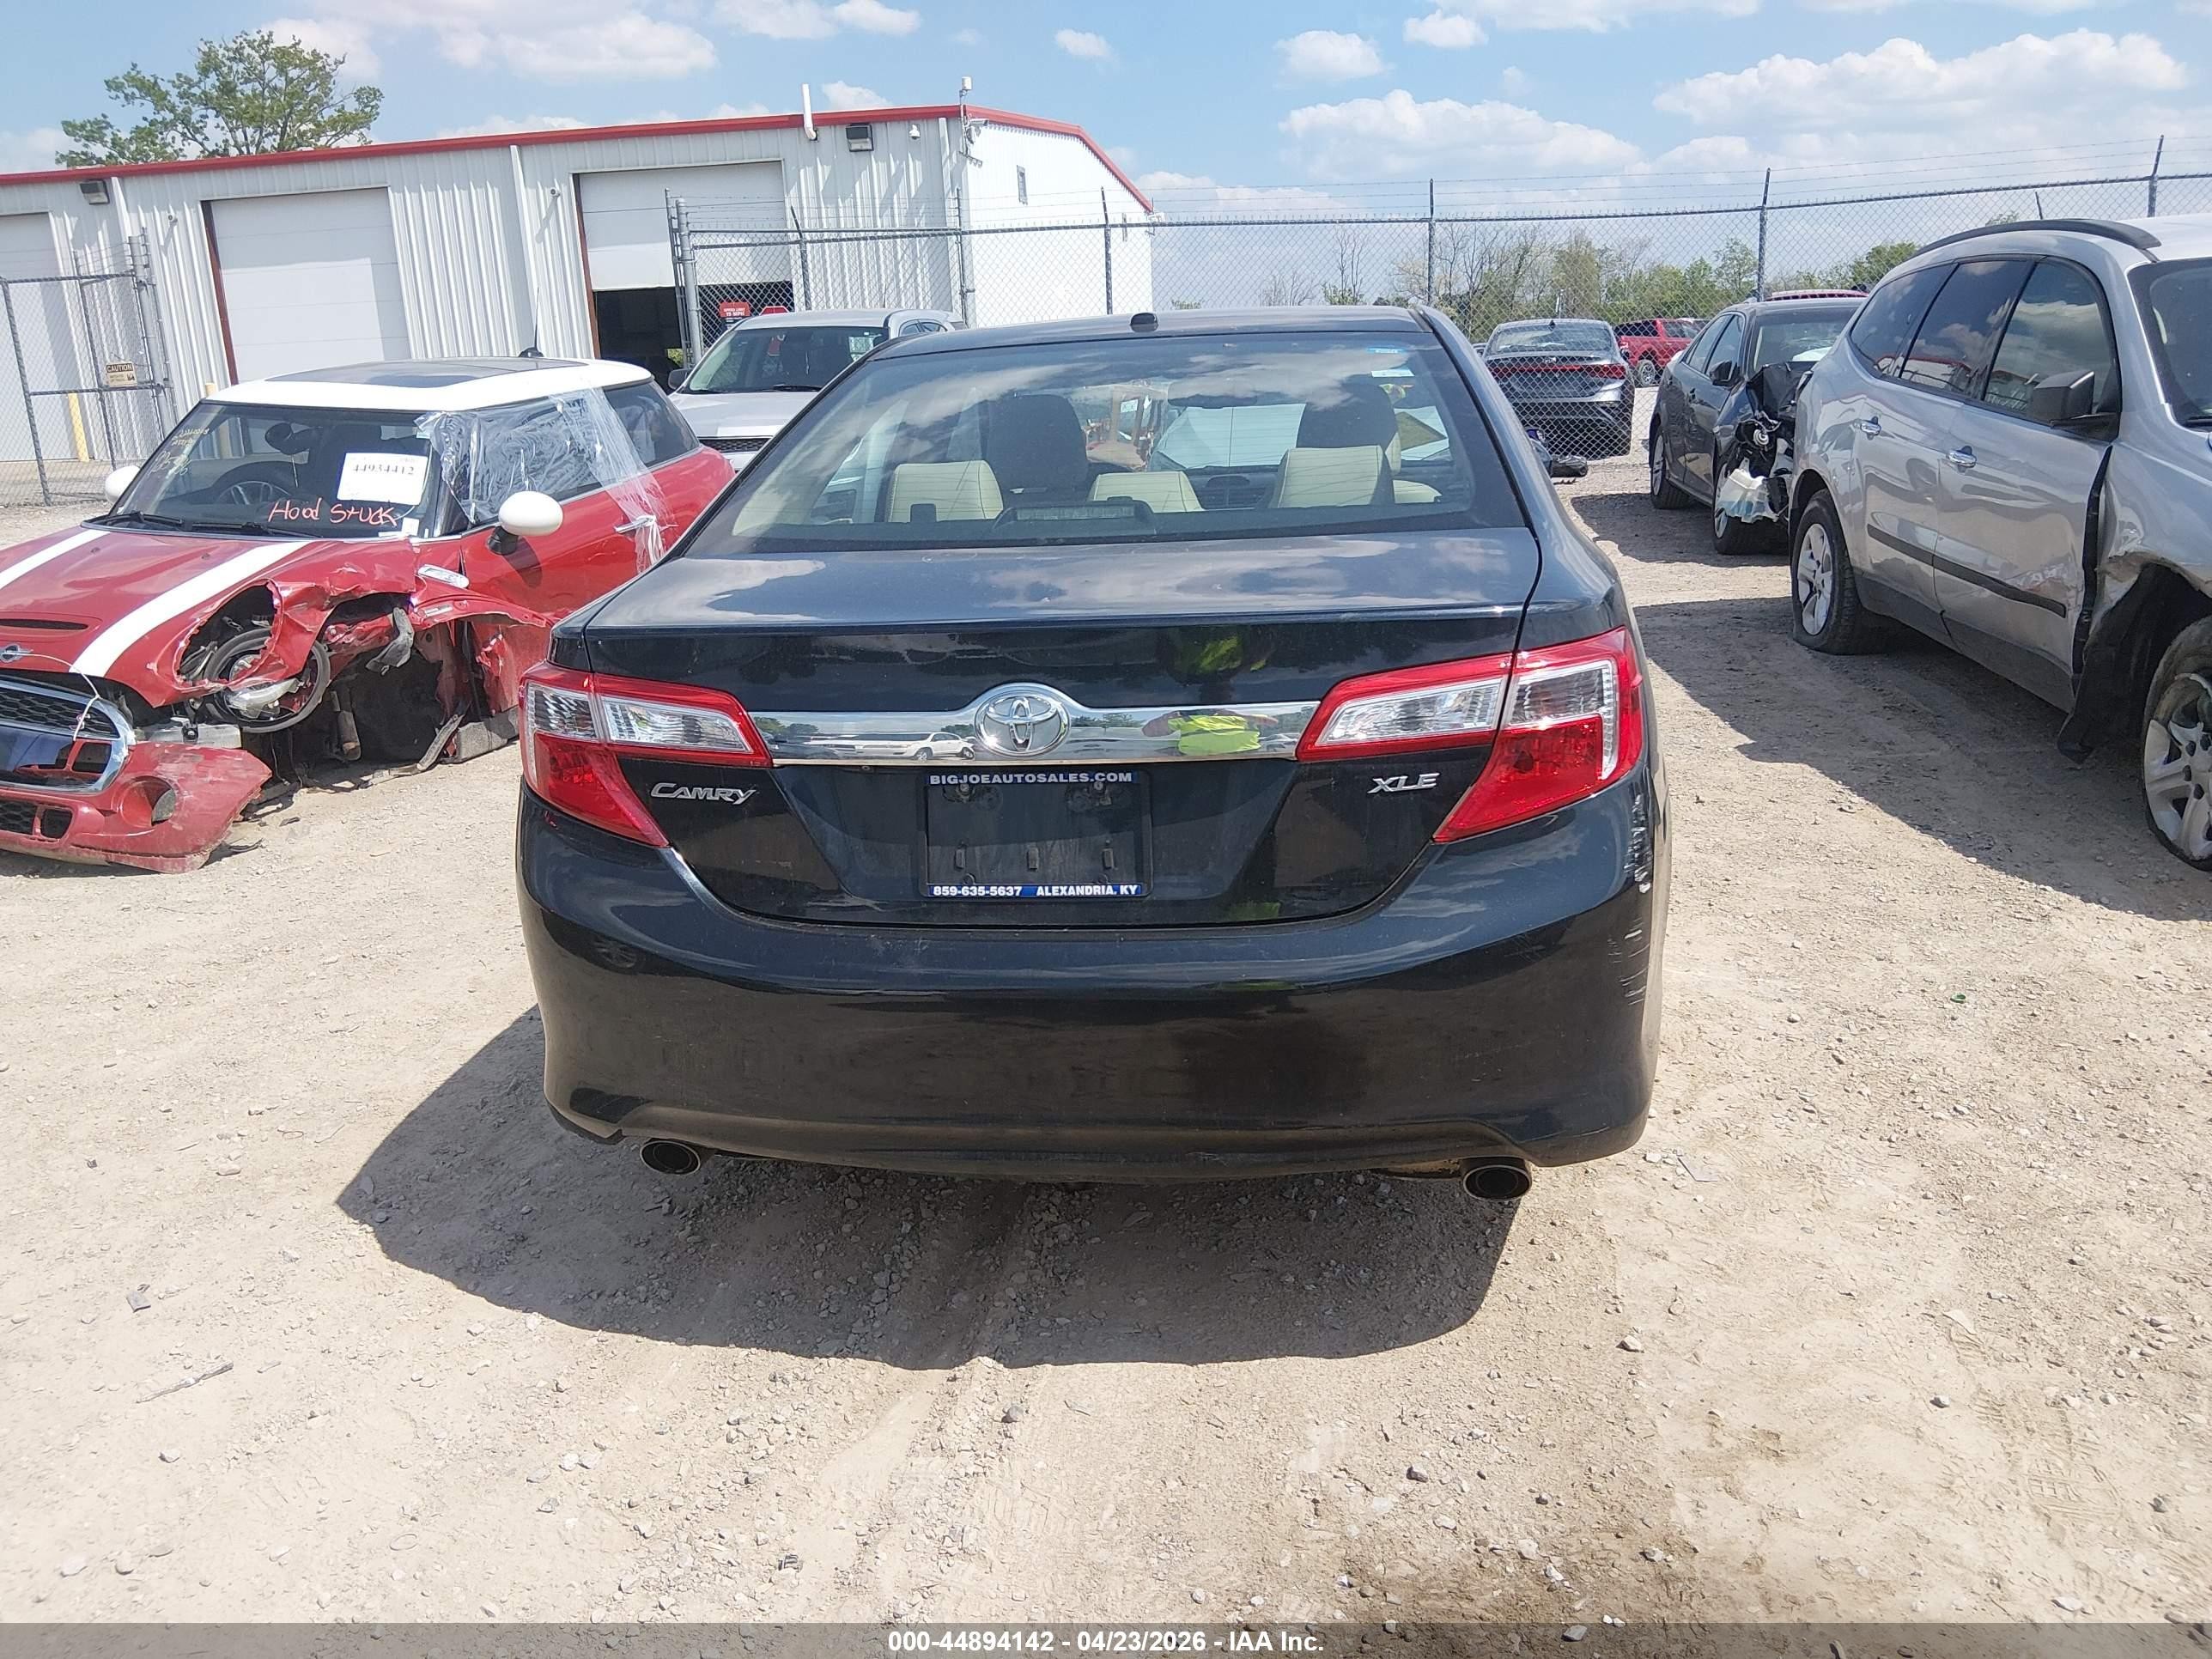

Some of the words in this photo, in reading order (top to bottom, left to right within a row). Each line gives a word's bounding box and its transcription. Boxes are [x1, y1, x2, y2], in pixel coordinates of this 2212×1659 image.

[930, 773, 1132, 785] BIGJOEAUTOSALES.COM
[1367, 773, 1440, 794] XLE
[933, 885, 1023, 896] 859-635-5637
[1120, 884, 1138, 895] KY
